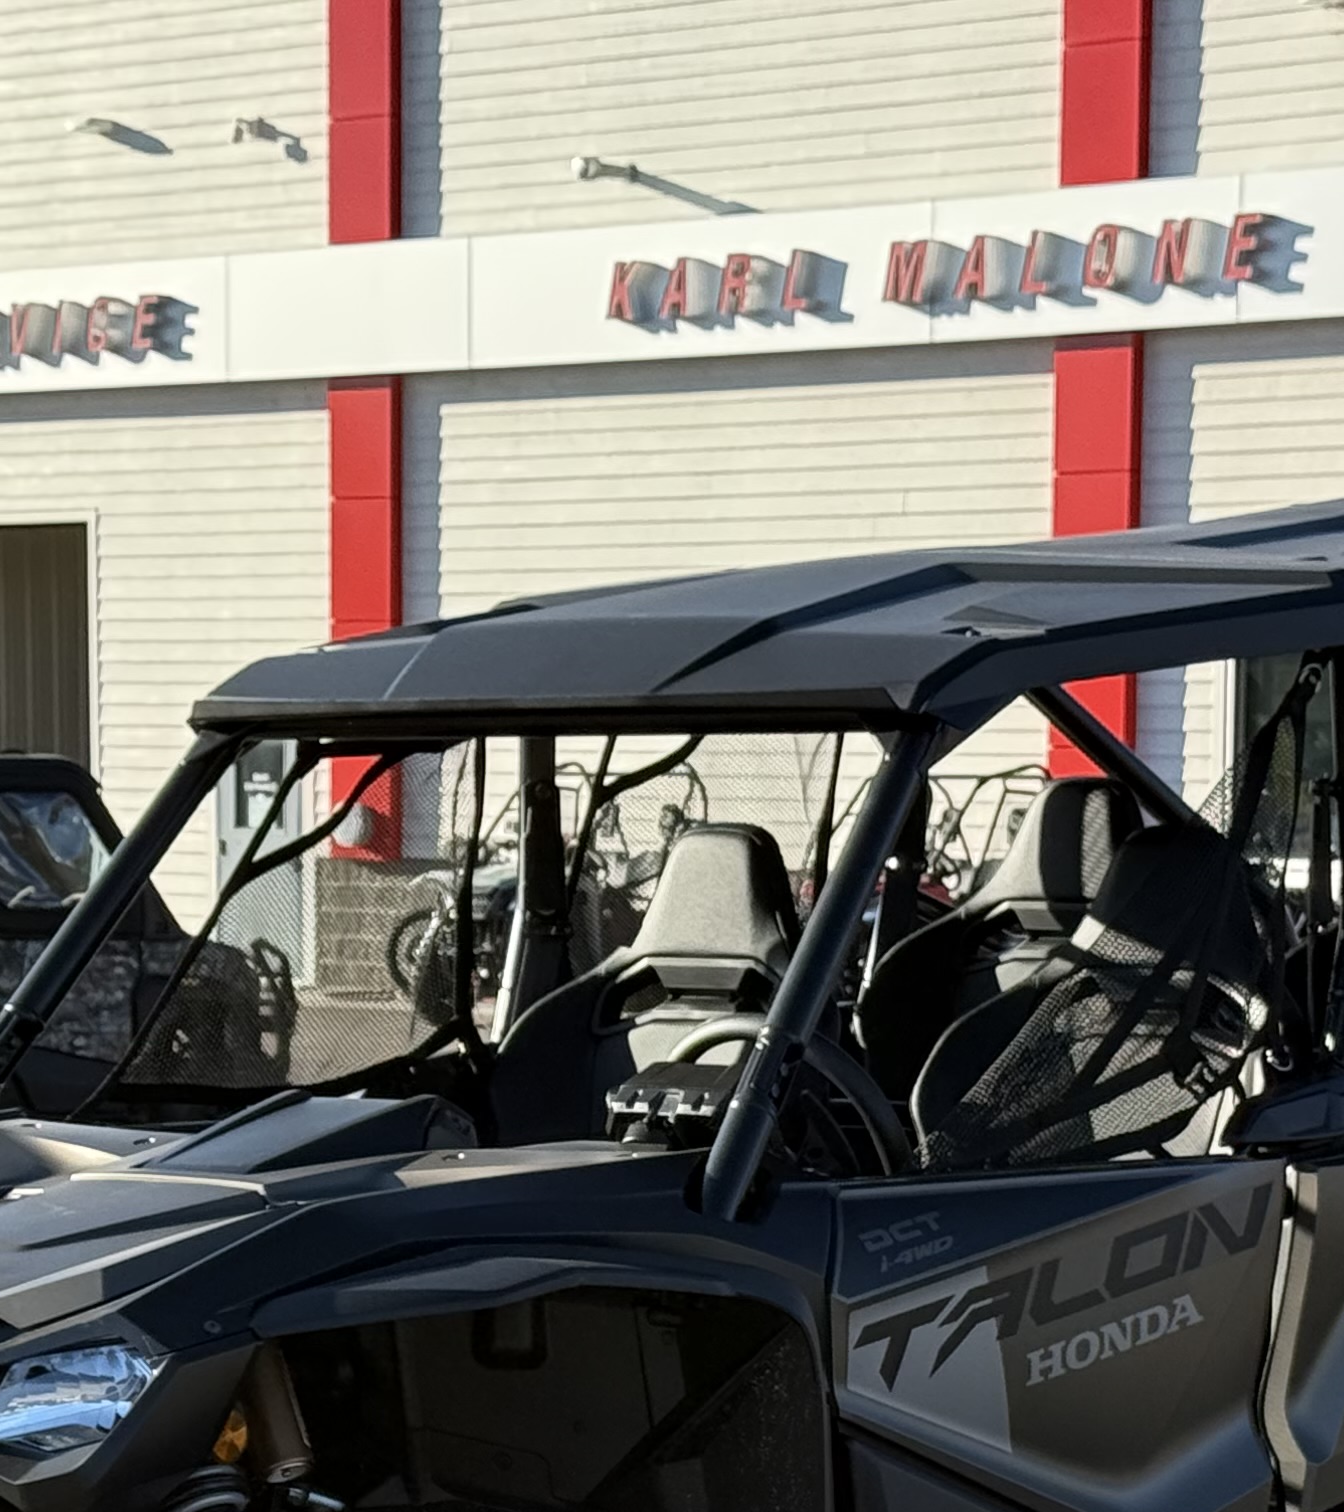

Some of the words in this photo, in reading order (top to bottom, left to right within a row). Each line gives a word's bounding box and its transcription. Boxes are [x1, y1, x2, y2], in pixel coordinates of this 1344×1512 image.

[606, 248, 810, 322] KARL
[881, 212, 1266, 304] MALONE
[857, 1210, 941, 1254] DCT
[852, 1183, 1273, 1393] TALON
[1025, 1293, 1204, 1387] HONDA
